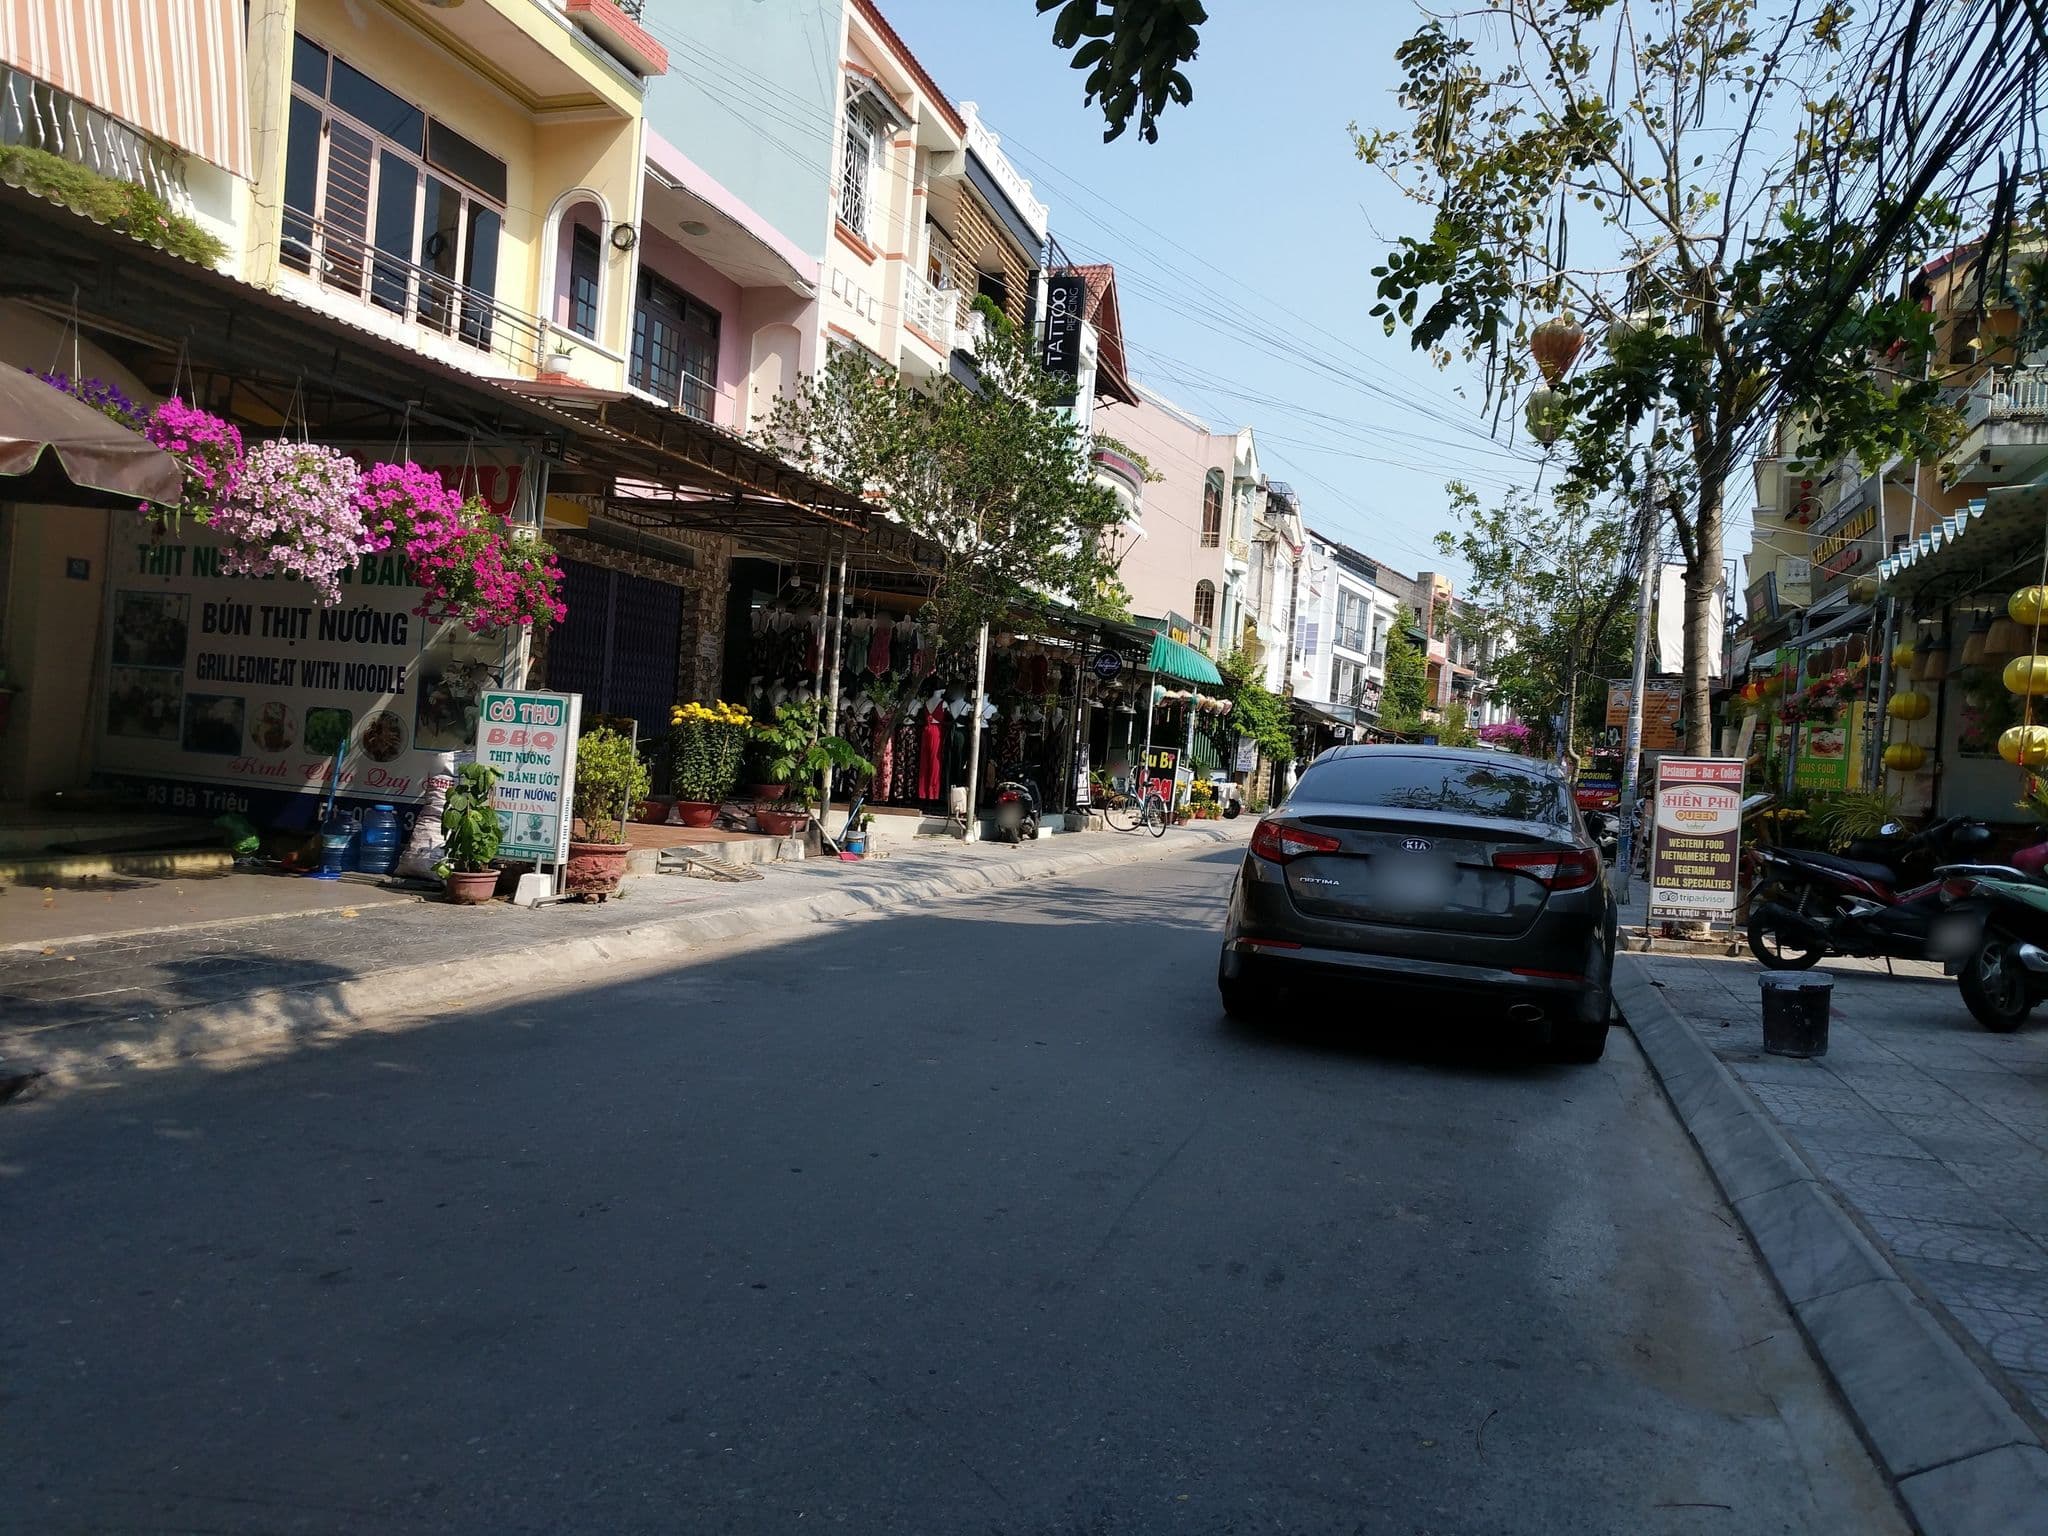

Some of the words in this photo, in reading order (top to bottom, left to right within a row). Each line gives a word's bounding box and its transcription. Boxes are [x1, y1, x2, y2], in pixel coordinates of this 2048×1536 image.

[1067, 287, 1078, 332] PIERCING
[1047, 288, 1067, 366] TATTOO
[202, 597, 252, 635] BÚN
[260, 605, 312, 646] THỊT
[318, 604, 408, 645] NƯỚNG
[197, 652, 298, 687] GRILLEDMEAT
[301, 659, 340, 690] WITH
[343, 663, 406, 695] NOODLE
[490, 698, 516, 722] CÔ
[519, 703, 559, 725] THU
[487, 728, 557, 751] BBQ
[1662, 765, 1697, 777] Restaurant
[1702, 767, 1715, 778] Bar
[1720, 767, 1741, 779] Coffee
[499, 787, 521, 801] THỊT
[1708, 796, 1733, 809] PHI
[1676, 810, 1718, 821] QUEEN
[1406, 840, 1427, 850] KIA
[1669, 838, 1703, 849] WESTERN
[1705, 840, 1724, 849] FOOD
[1661, 850, 1709, 861] VIETNAMESE
[1710, 853, 1731, 863] FOOD
[1674, 865, 1716, 876] VEGETARIAN
[1299, 877, 1340, 885] OPTIMA
[1656, 877, 1681, 887] LOCAL
[1682, 879, 1732, 889] SPECIALTIES
[1679, 894, 1726, 903] tripadvisor
